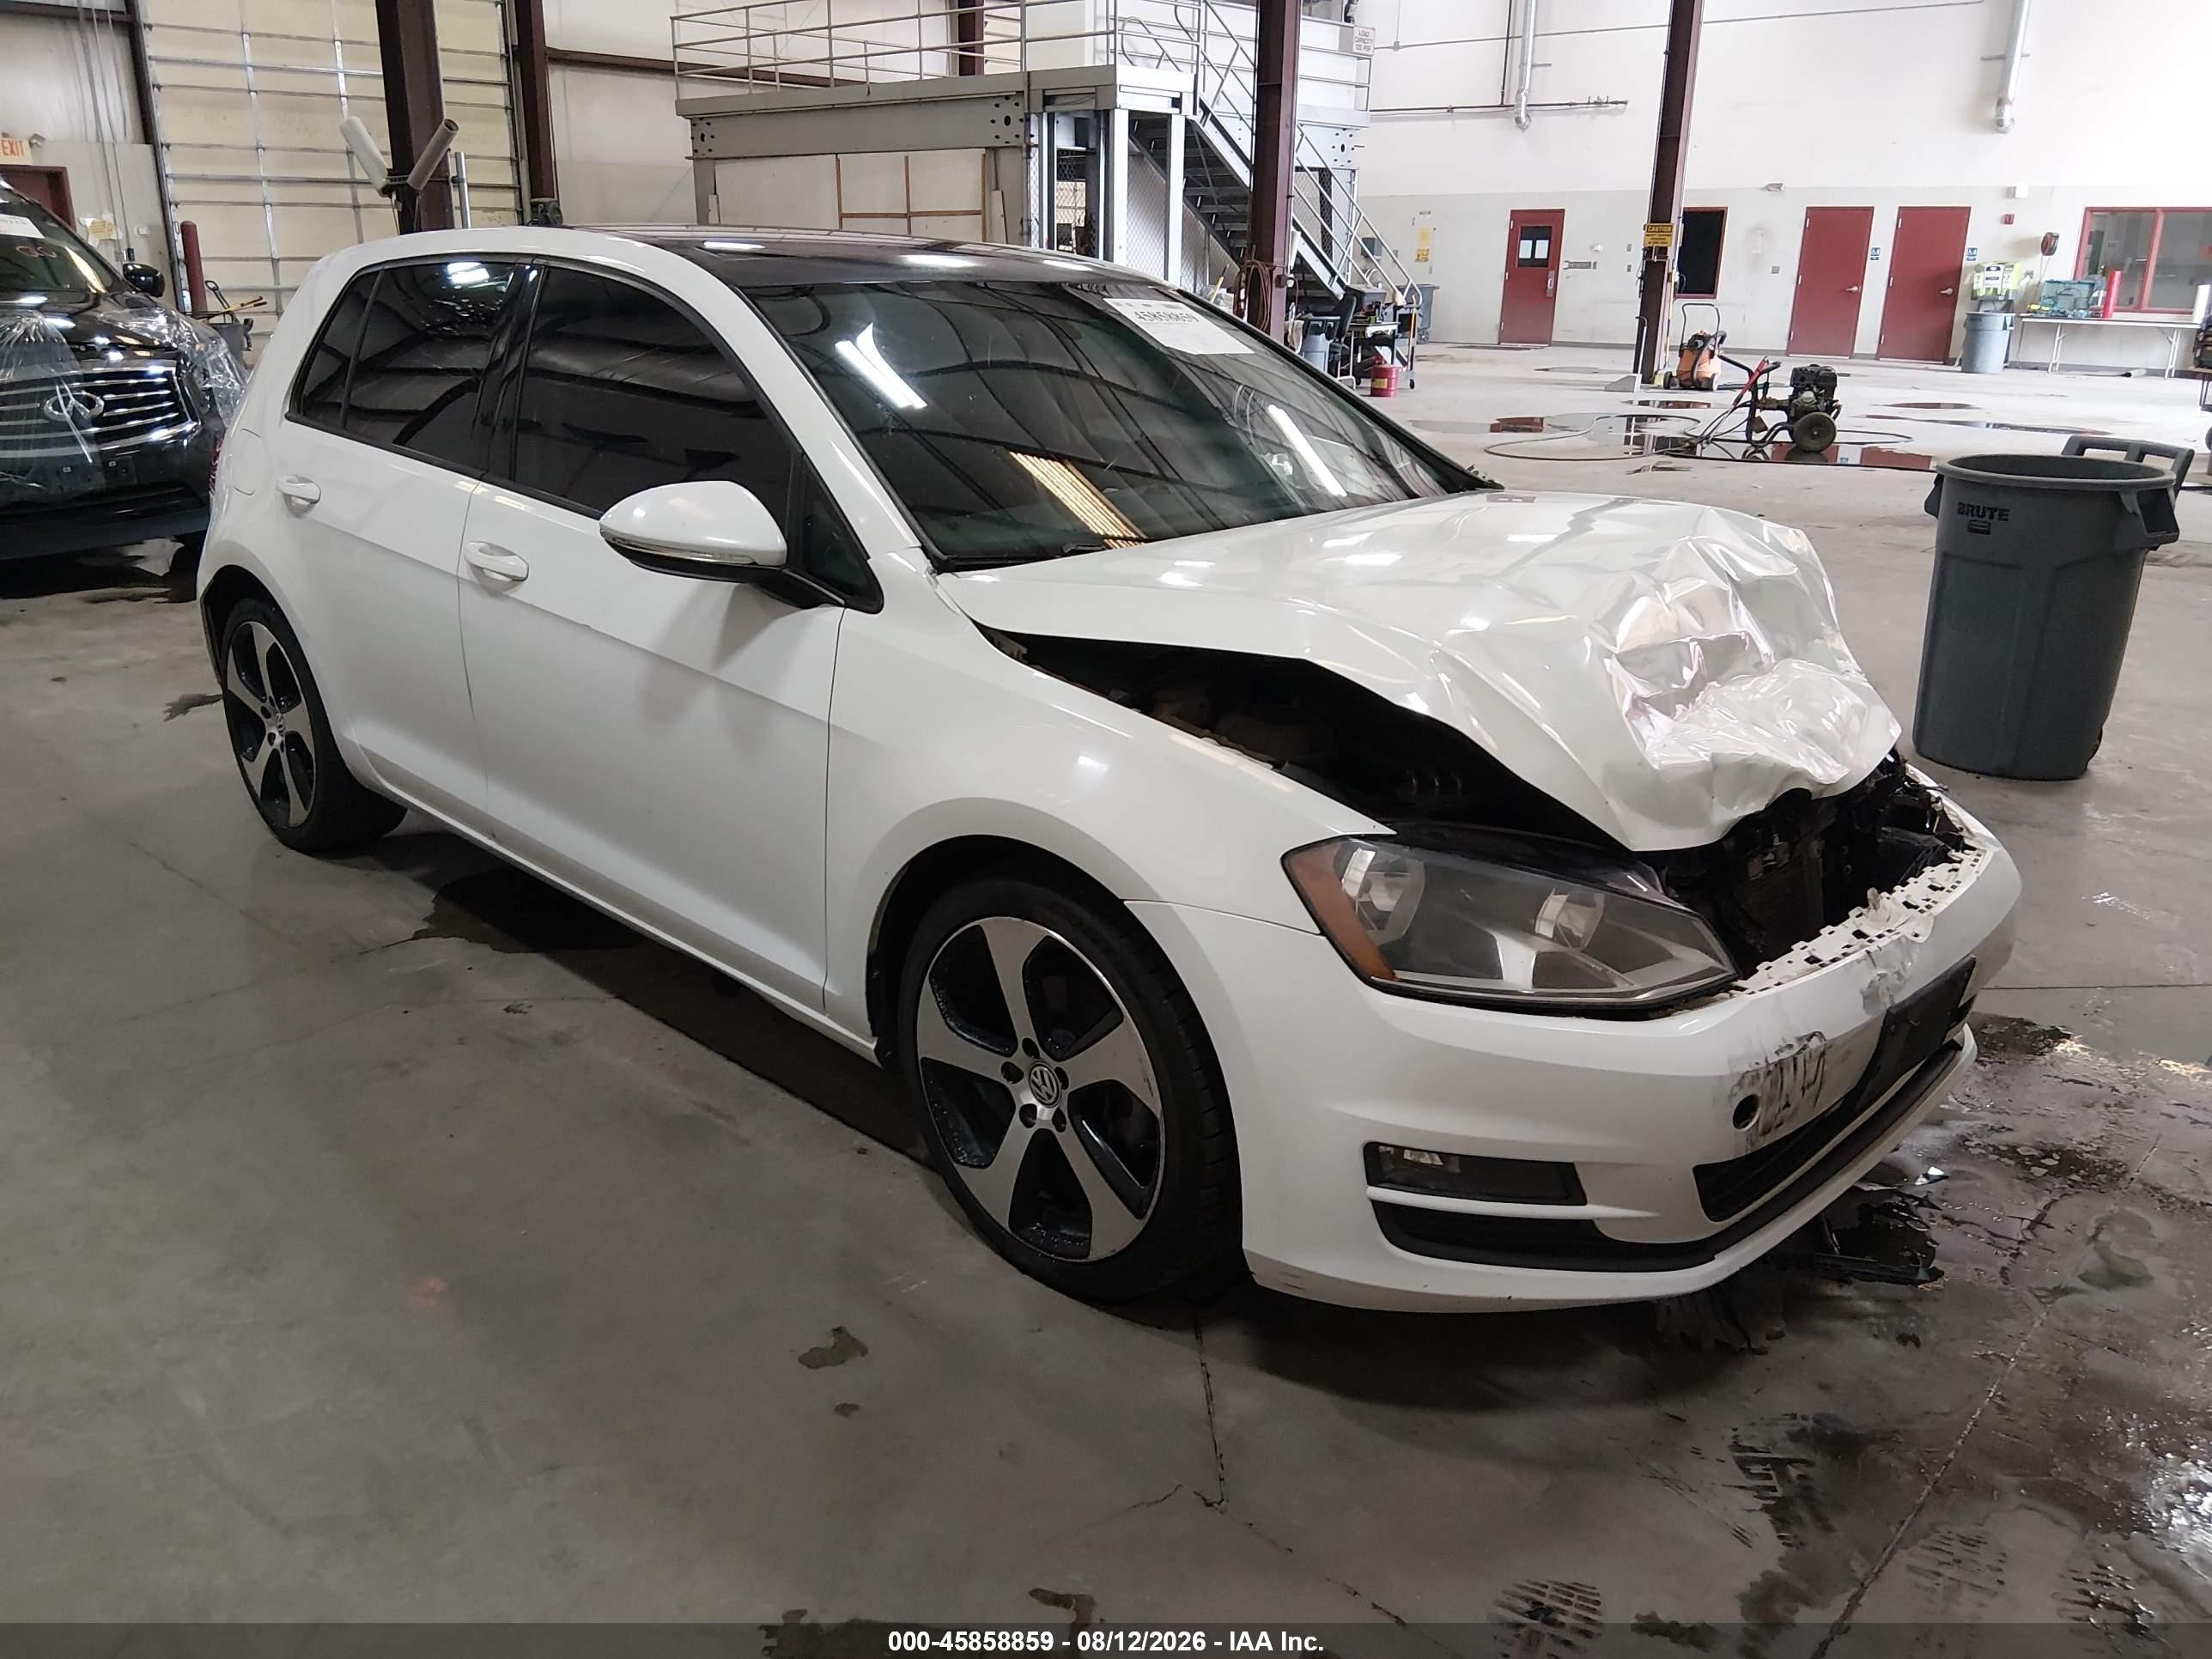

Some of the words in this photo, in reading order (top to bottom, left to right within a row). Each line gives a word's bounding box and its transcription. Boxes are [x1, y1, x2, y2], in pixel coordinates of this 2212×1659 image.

[1, 139, 25, 156] EXIT
[1133, 311, 1200, 323] 45858859
[1957, 501, 2010, 521] BRUTE
